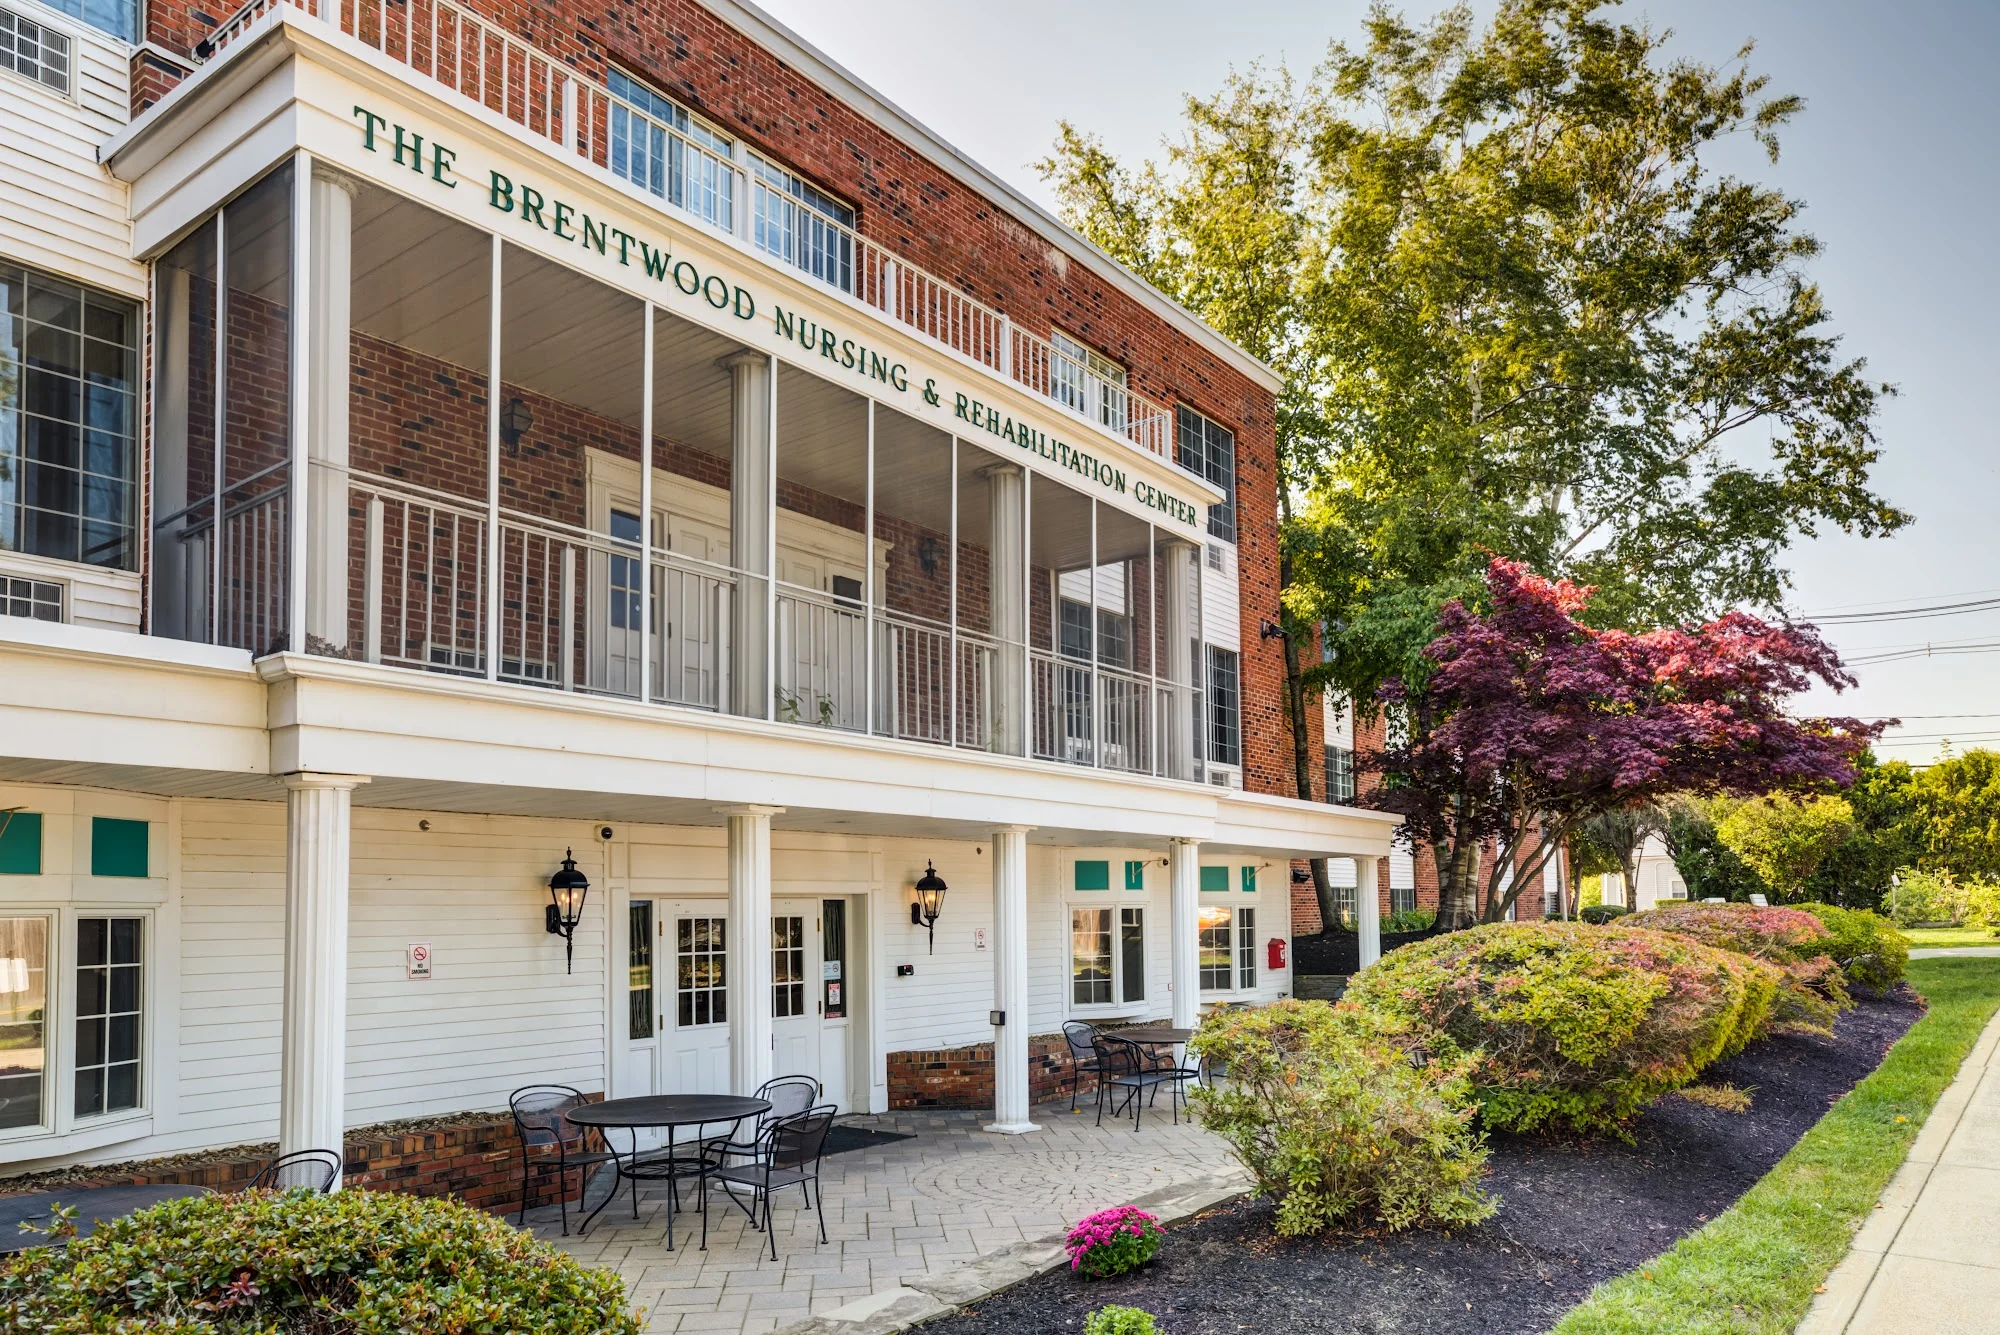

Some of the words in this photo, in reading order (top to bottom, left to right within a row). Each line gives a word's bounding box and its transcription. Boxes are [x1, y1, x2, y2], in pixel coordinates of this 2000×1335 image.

[353, 105, 458, 188] THE
[488, 170, 755, 321] BRENTWOOD
[774, 305, 908, 393] NURSING
[922, 378, 941, 408] &
[954, 391, 1127, 495] REHABILITATION
[1134, 480, 1198, 528] CENTER
